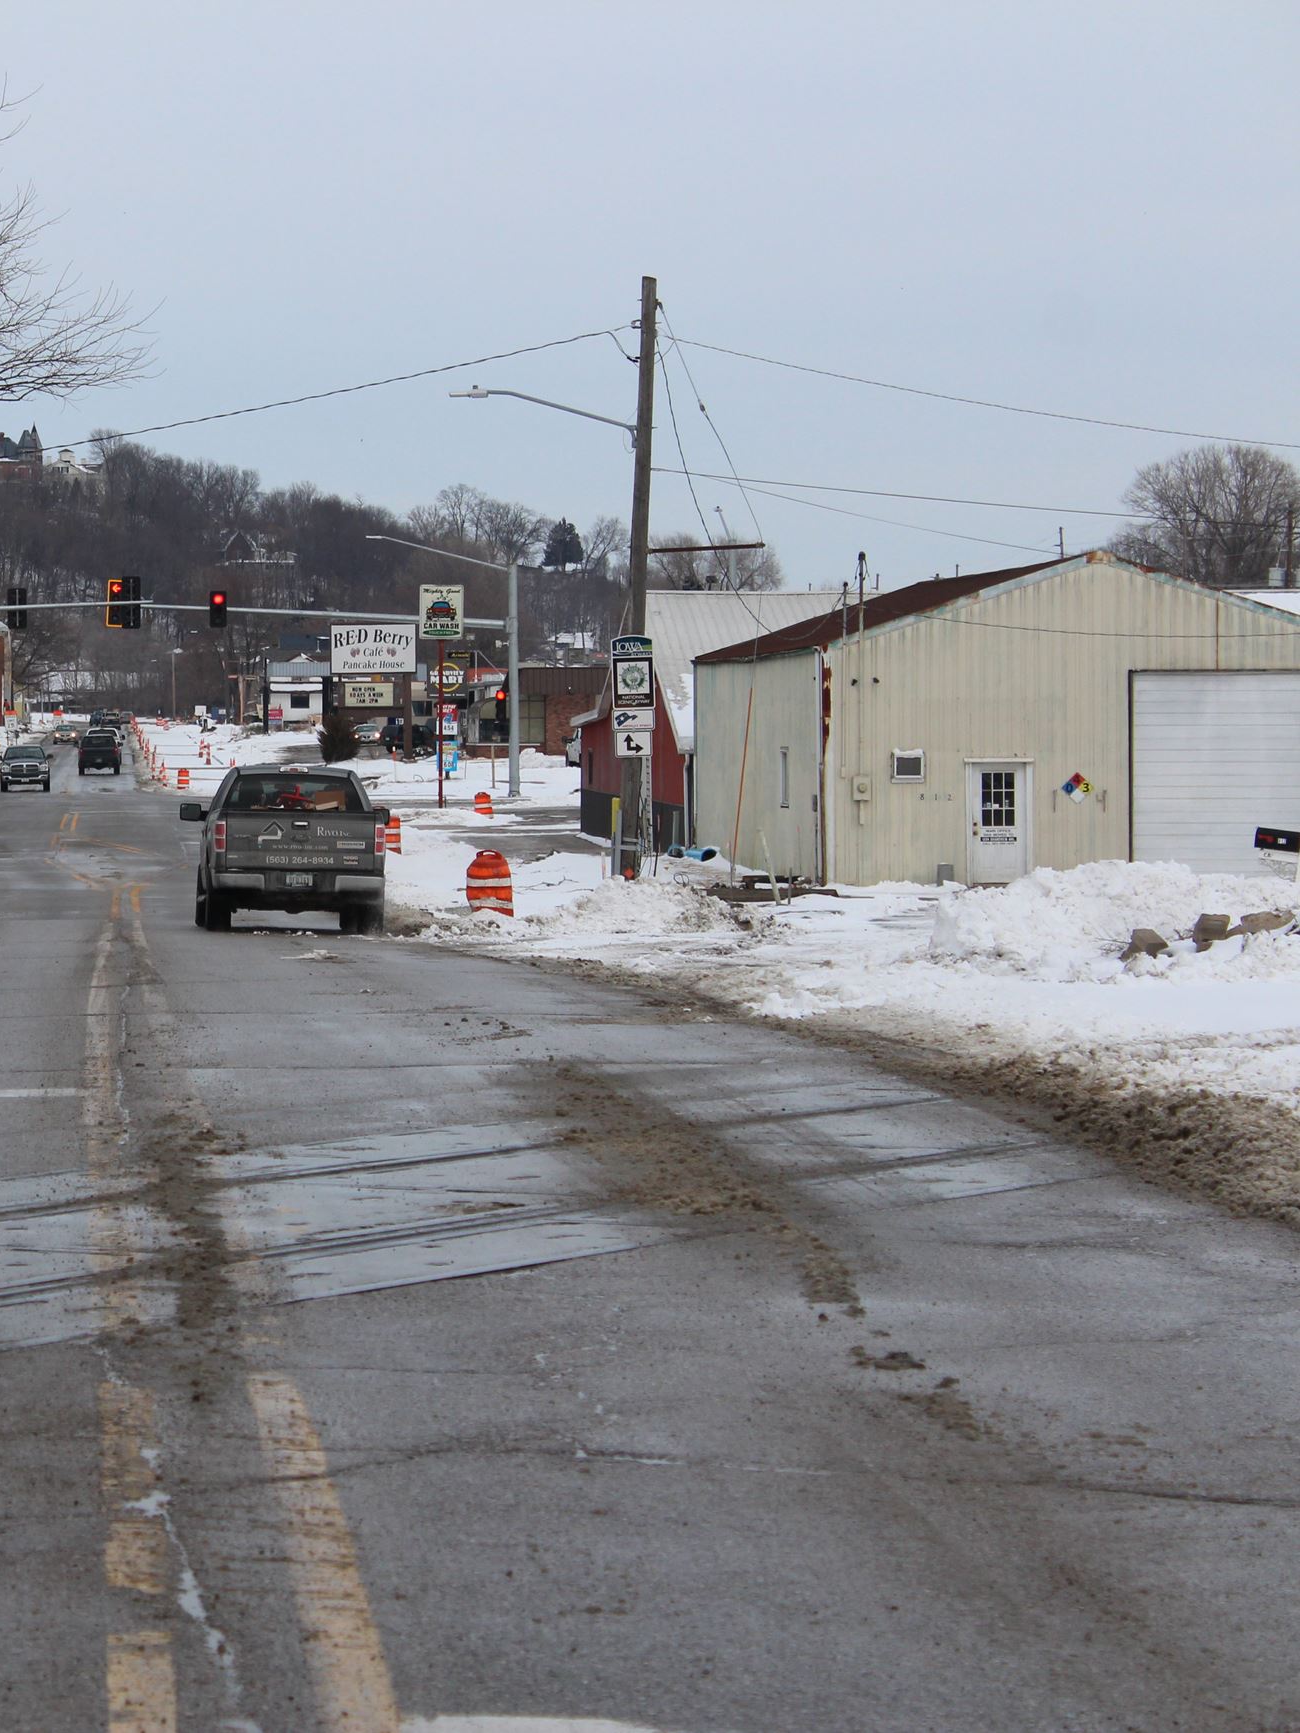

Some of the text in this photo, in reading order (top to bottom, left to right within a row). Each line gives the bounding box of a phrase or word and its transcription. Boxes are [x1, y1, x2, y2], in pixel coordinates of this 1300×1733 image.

[373, 628, 413, 650] Berry
[616, 641, 643, 652] IOWA
[363, 647, 384, 657] Café
[342, 660, 405, 669] Pancake House
[430, 676, 464, 684] MART
[1082, 782, 1090, 792] 3
[266, 855, 289, 865] (563)
[292, 855, 334, 865] 264-8934
